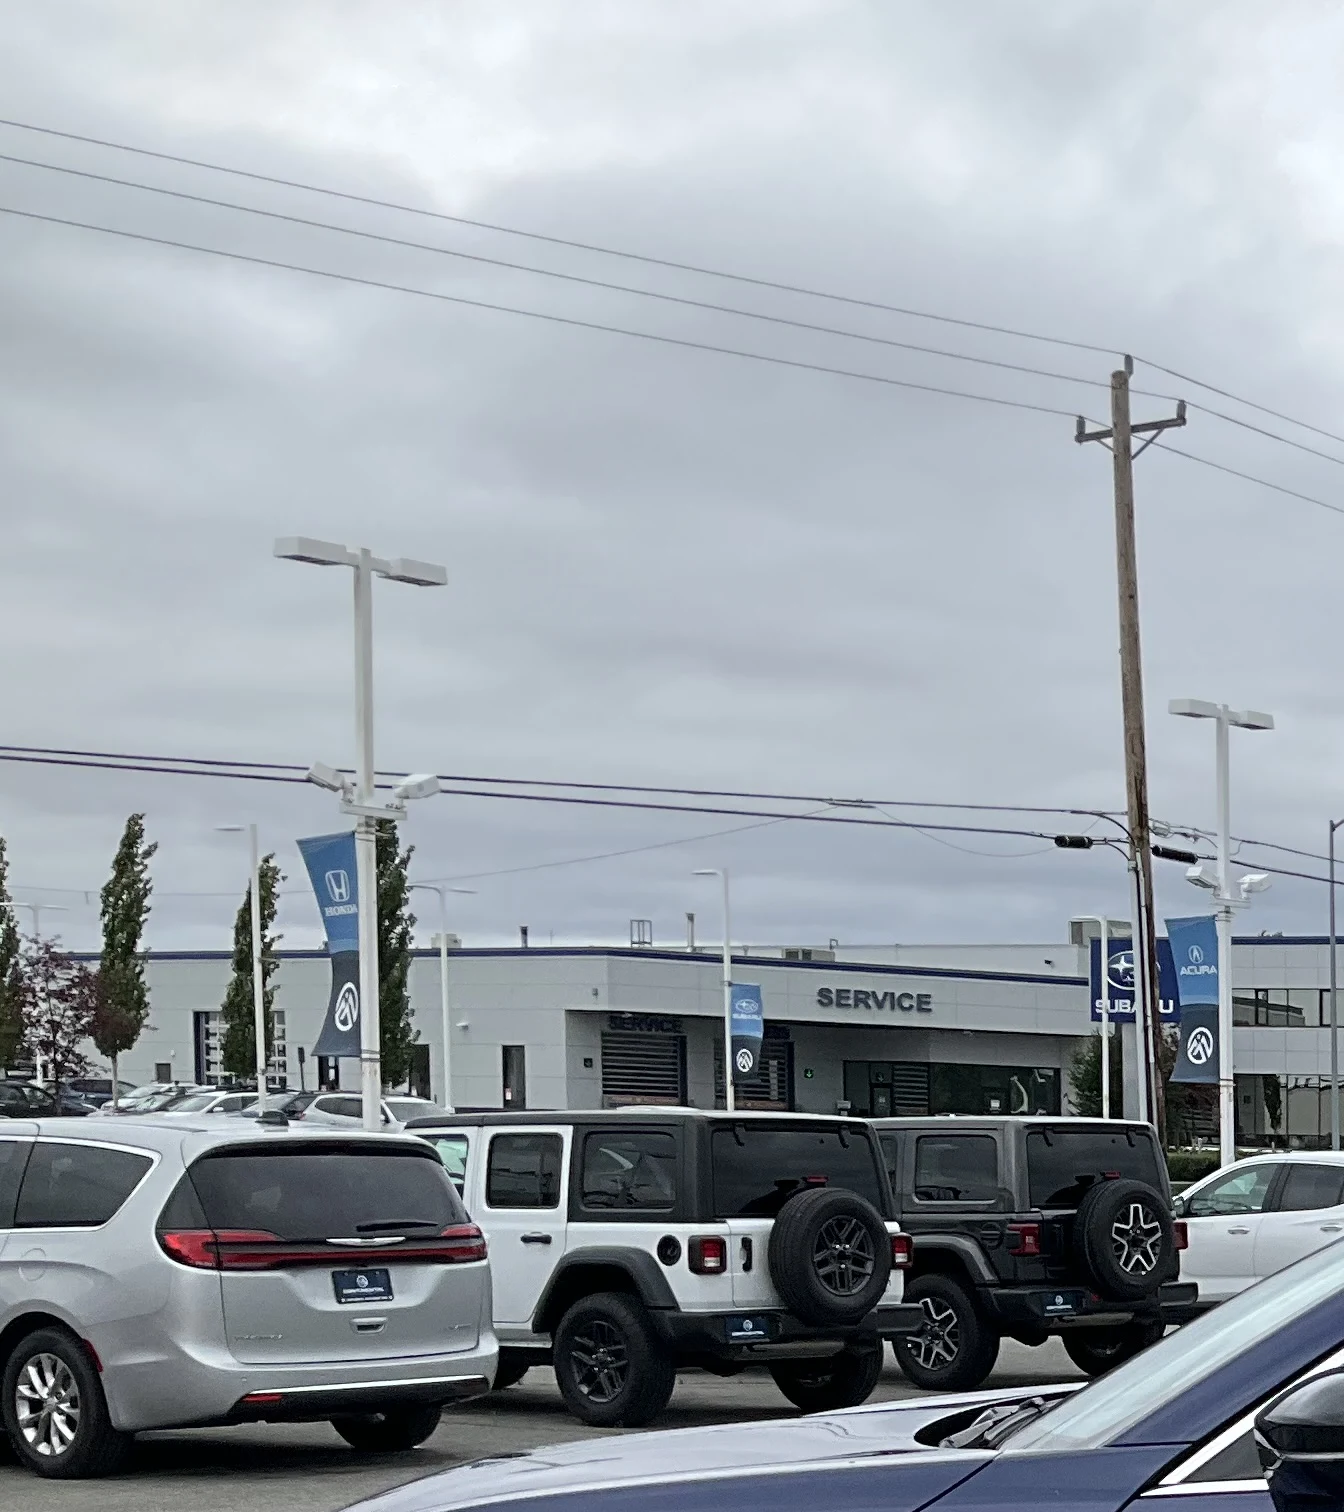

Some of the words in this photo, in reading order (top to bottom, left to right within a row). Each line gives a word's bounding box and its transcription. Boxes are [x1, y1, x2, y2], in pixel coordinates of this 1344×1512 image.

[1180, 965, 1217, 975] ACURA
[816, 987, 933, 1013] SERVICE
[1095, 998, 1174, 1014] SUBU
